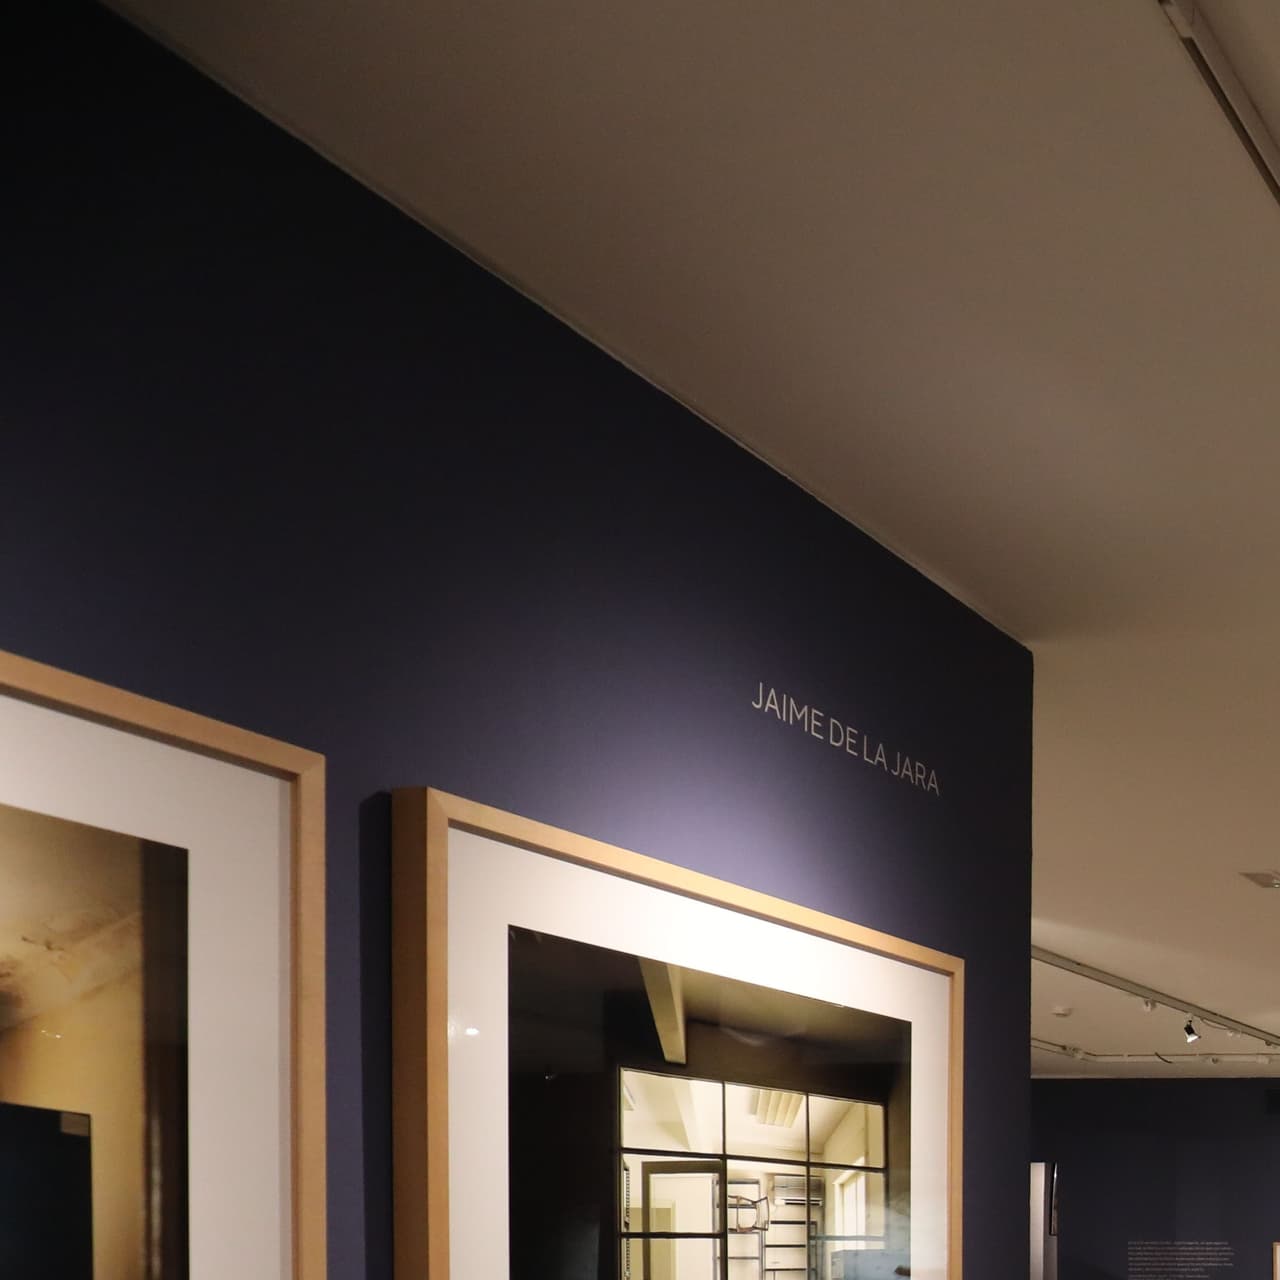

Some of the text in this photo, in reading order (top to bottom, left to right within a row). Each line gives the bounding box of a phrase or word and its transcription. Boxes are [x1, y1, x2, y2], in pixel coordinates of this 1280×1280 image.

[751, 682, 940, 796] JAIME DE LA JARA
